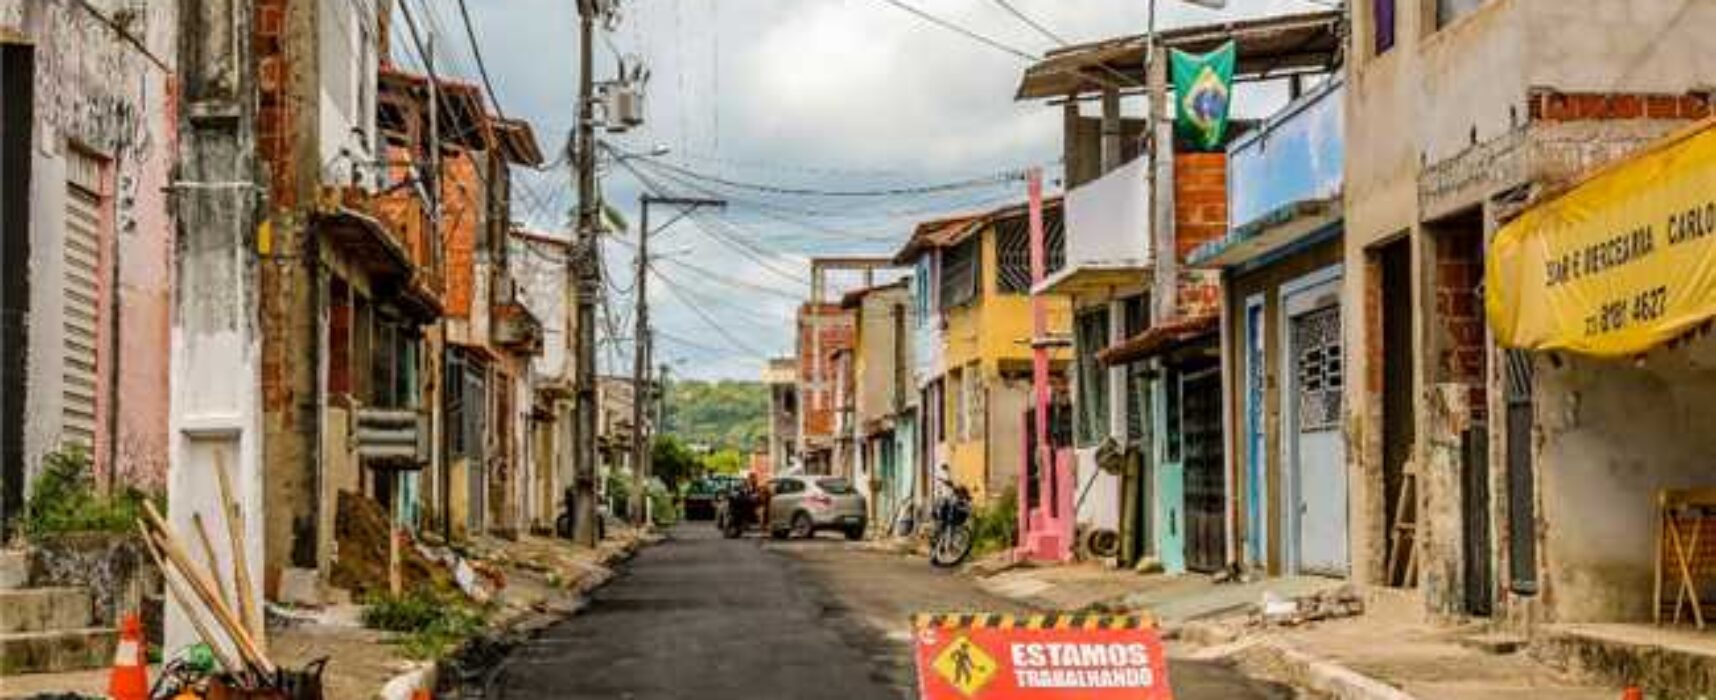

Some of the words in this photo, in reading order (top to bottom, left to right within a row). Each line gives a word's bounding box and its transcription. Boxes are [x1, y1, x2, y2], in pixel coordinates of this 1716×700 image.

[1573, 250, 1581, 278] E
[1633, 285, 1666, 320] 4627
[1011, 643, 1147, 666] ESTAMOS
[1014, 668, 1152, 687] TRABALHANDO
